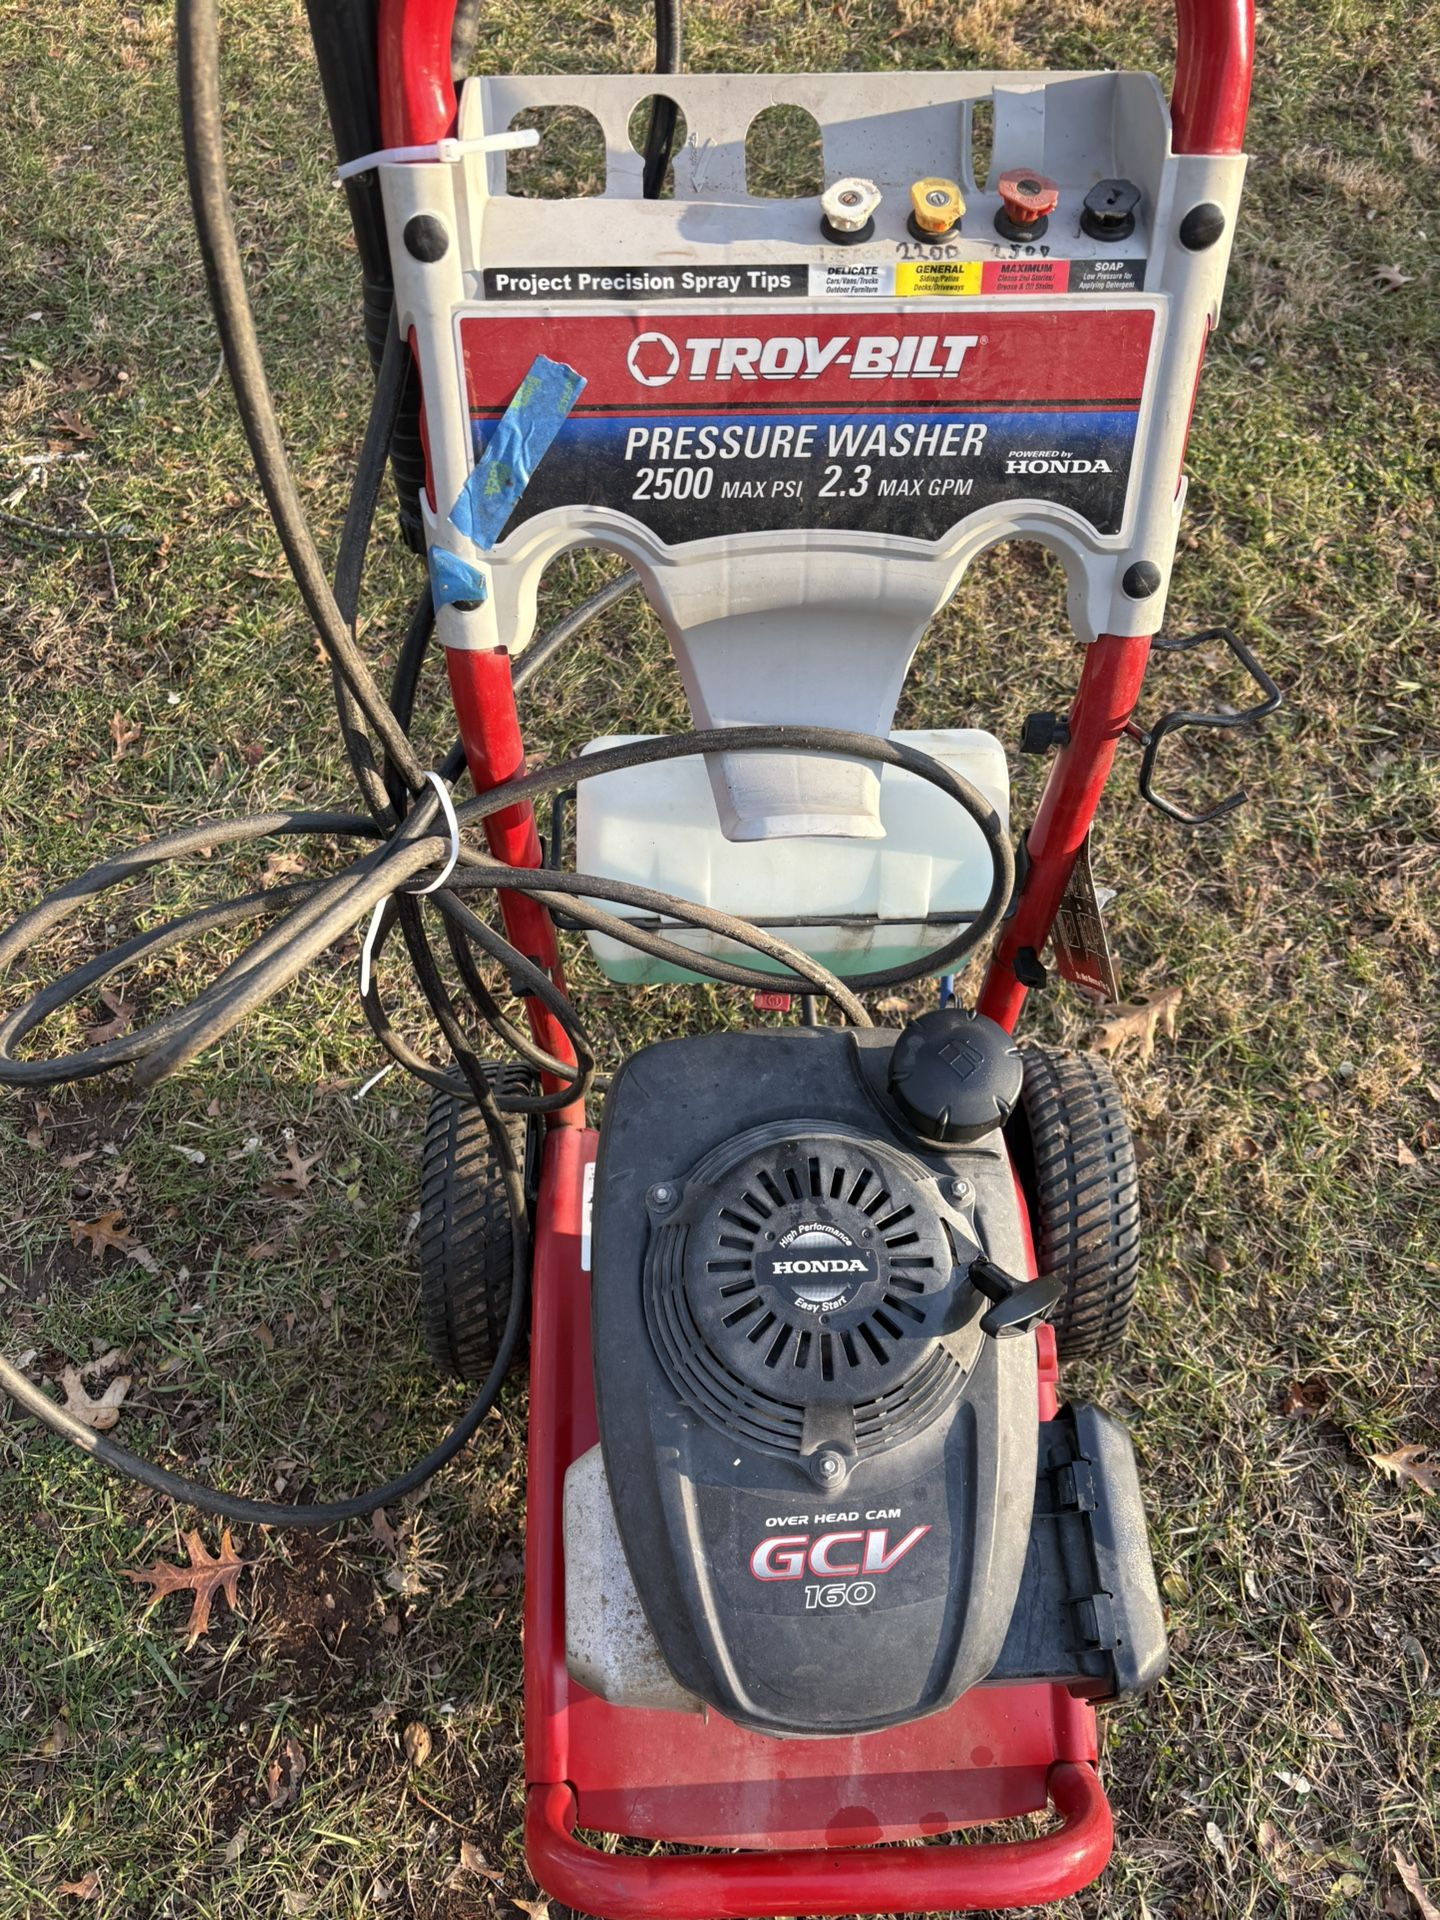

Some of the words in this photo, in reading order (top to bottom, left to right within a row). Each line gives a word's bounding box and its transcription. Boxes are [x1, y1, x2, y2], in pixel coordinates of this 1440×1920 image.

[896, 242, 958, 260] 2200
[991, 243, 1050, 260] 2500
[827, 266, 879, 275] DELICATE
[915, 264, 965, 274] GENERAL
[1001, 264, 1053, 273] MAXIMUM
[1094, 262, 1124, 271] SOAP
[496, 274, 571, 295] Project
[578, 272, 675, 291] Precision
[682, 272, 740, 293] Spray
[747, 271, 791, 292] Tips
[826, 277, 879, 285] Cars/Vans/Trucks
[919, 275, 960, 283] Siding/Patios
[1078, 281, 1105, 290] Applying
[1105, 280, 1136, 290] Detergent
[1083, 273, 1096, 281] Low
[1096, 273, 1123, 281] Pressure
[826, 286, 850, 294] Outdoor
[850, 286, 879, 294] Furniture
[913, 284, 965, 292] Decks/Driveways
[685, 335, 980, 381] TROY-BILT
[624, 424, 818, 460] PRESSURE
[827, 423, 989, 458] WASHER
[1007, 450, 1058, 459] POWERED
[1060, 450, 1073, 460] by
[1004, 459, 1112, 475] HONDA
[632, 467, 714, 501] 2500
[720, 480, 769, 499] MAX
[771, 479, 803, 499] PSI
[818, 465, 870, 498] 2.3
[878, 478, 925, 497] MAX
[927, 478, 974, 497] GPM
[778, 1230, 798, 1249] High
[798, 1222, 853, 1248] Performance
[772, 1259, 869, 1275] HONDA
[794, 1297, 820, 1314] Easy
[821, 1295, 847, 1312] Start
[765, 1515, 809, 1528] OVER
[814, 1511, 860, 1524] HEAD
[865, 1508, 902, 1521] CAM
[749, 1524, 933, 1582] GCV
[804, 1581, 877, 1610] 160
